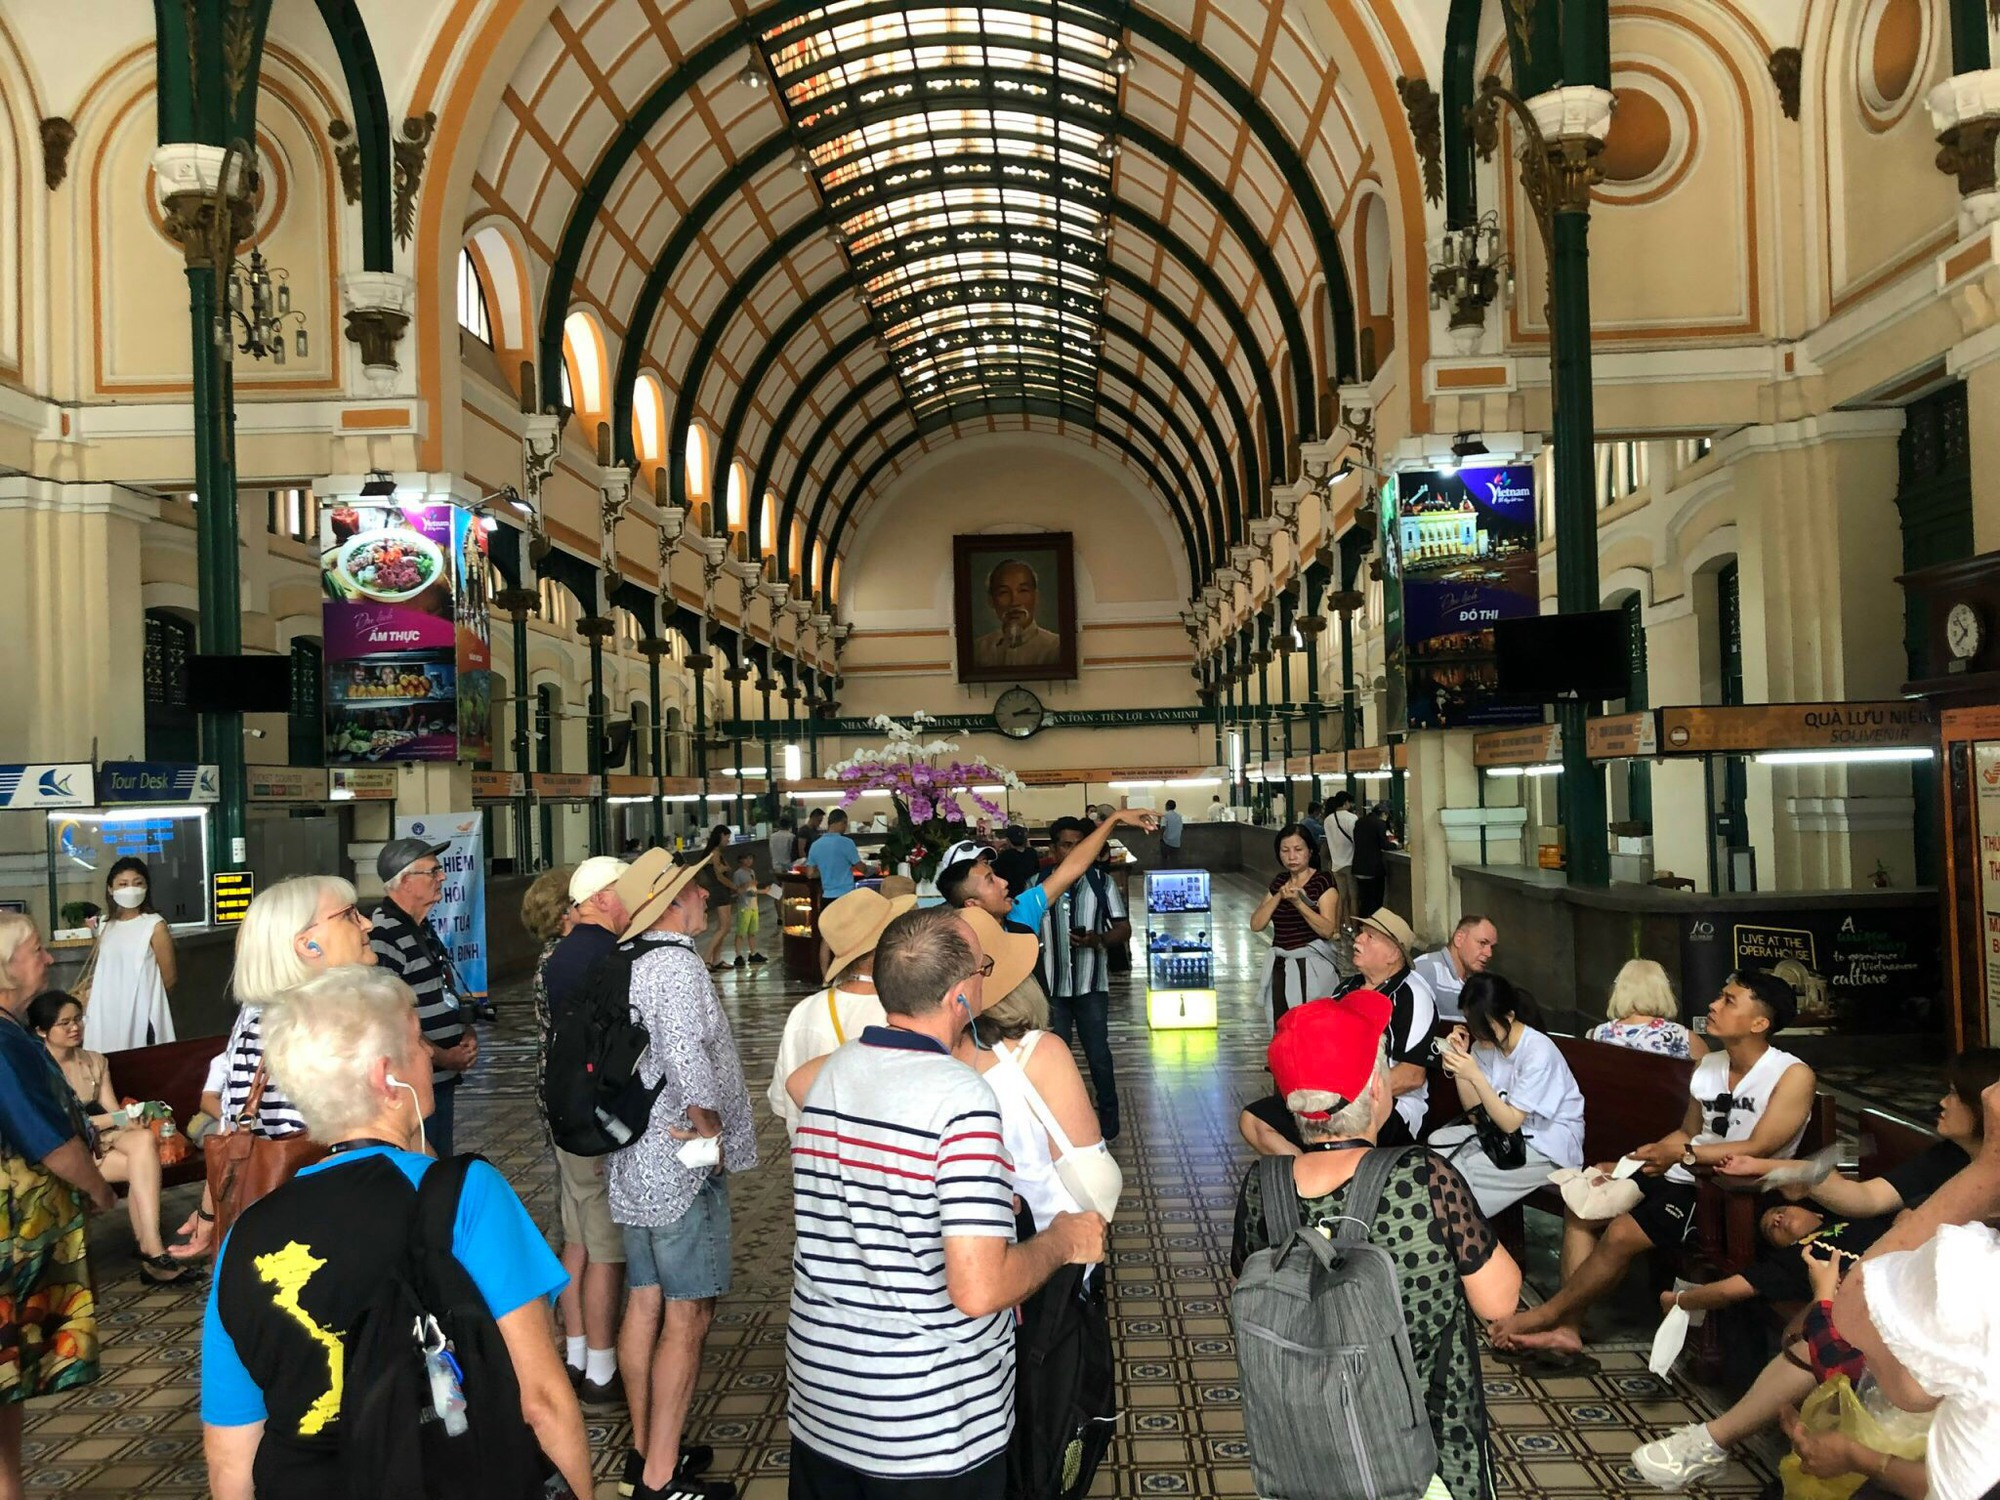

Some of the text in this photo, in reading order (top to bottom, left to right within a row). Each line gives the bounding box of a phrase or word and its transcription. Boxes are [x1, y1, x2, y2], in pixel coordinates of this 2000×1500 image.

[389, 630, 421, 643] THỰC
[964, 714, 986, 726] XÁC
[1068, 712, 1093, 723] TOÀN
[1172, 710, 1199, 720] MINH
[1804, 708, 1843, 728] QUÀ
[1850, 710, 1884, 726] LƯU
[1830, 728, 1911, 744] SOUVENIR
[110, 772, 169, 790] Tour Desk
[444, 846, 475, 872] HIỂM
[1841, 915, 1855, 933] A
[1742, 933, 1804, 949] LIVE AT THE
[1739, 944, 1810, 961] OPERA HOUSE
[1833, 950, 1845, 962] to
[1832, 961, 1888, 986] culture
